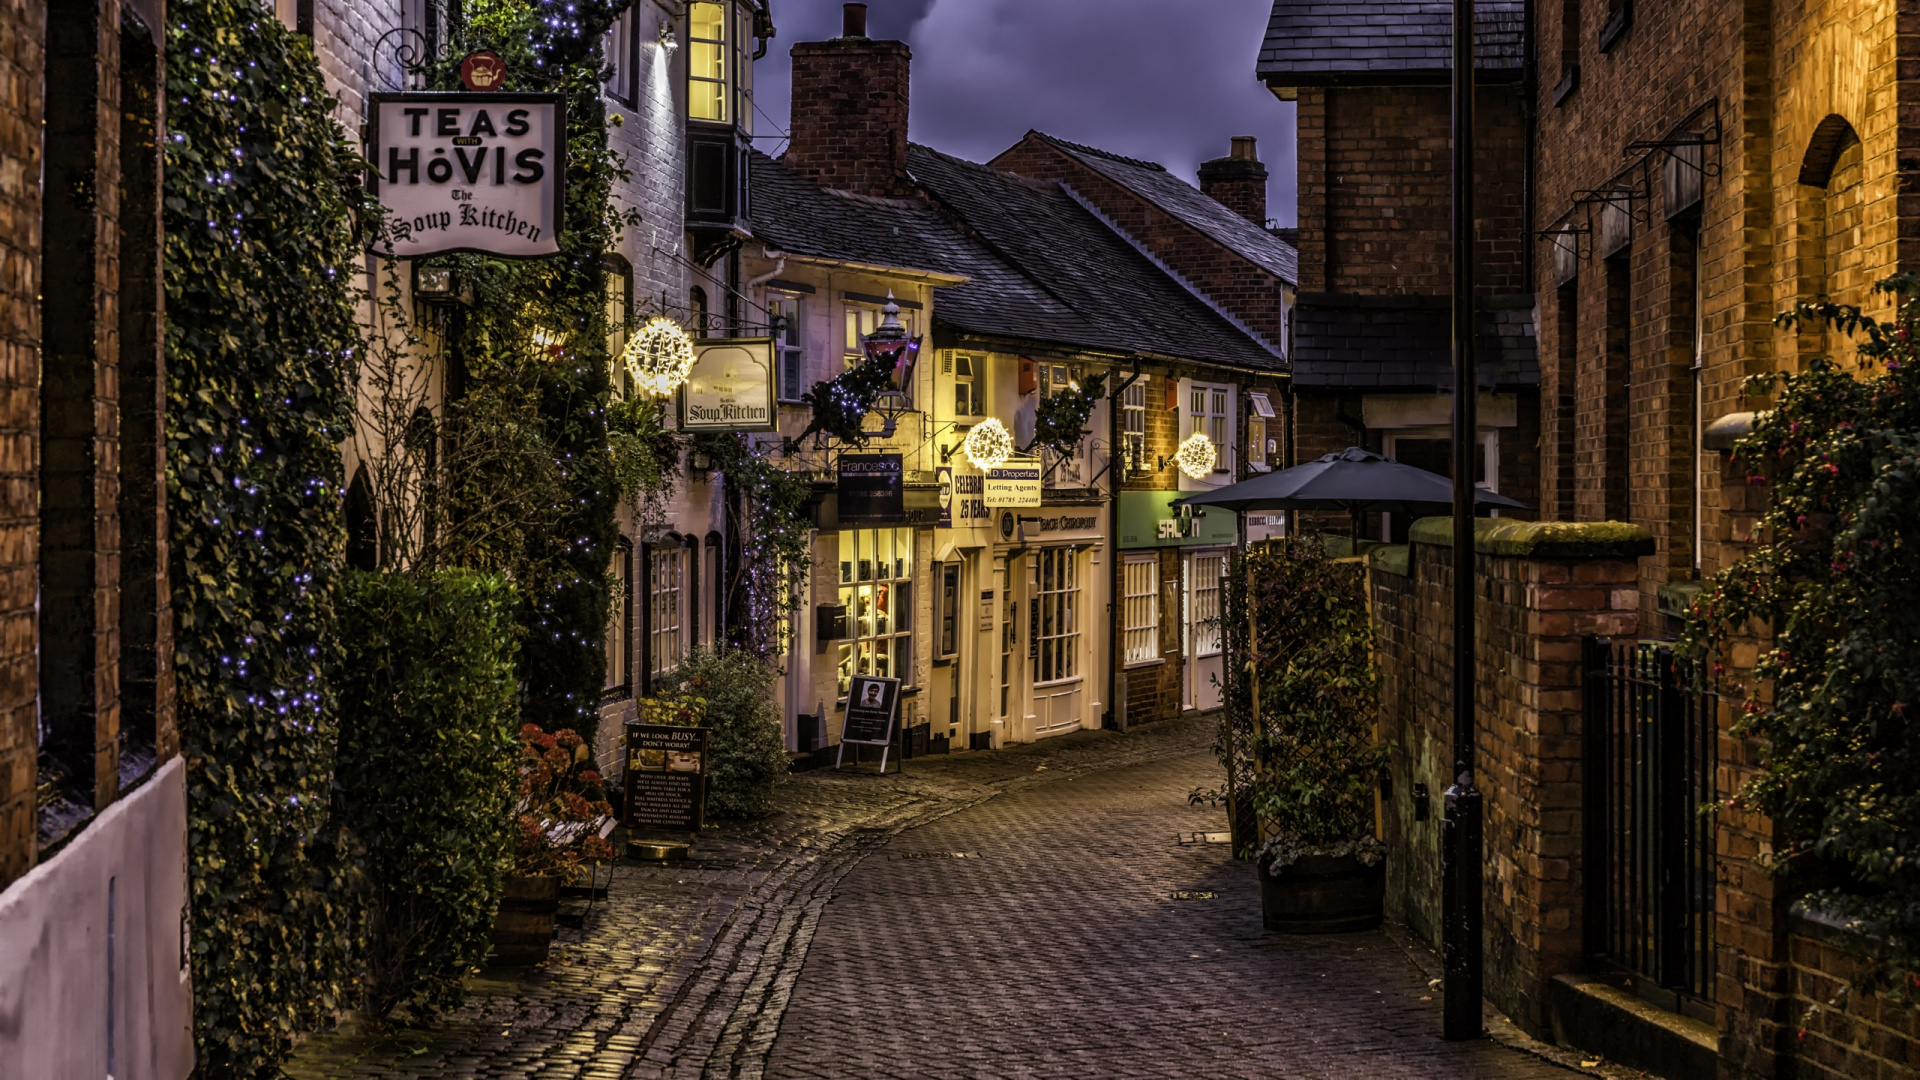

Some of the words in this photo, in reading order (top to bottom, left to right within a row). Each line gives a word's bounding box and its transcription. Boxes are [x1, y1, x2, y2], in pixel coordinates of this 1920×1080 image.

[404, 108, 530, 136] TEAS
[456, 137, 478, 145] WITH
[451, 189, 472, 201] The
[390, 210, 450, 243] Soup
[458, 204, 542, 243] Kitchen
[689, 404, 720, 422] Soup
[720, 404, 766, 422] Kitchen
[840, 460, 900, 472] Francesco
[1003, 469, 1038, 479] Properties
[955, 474, 984, 494] CELEBRAT
[988, 484, 1012, 492] Letting
[1014, 484, 1037, 492] Agents
[960, 499, 969, 518] 25
[970, 500, 990, 518] YEARS
